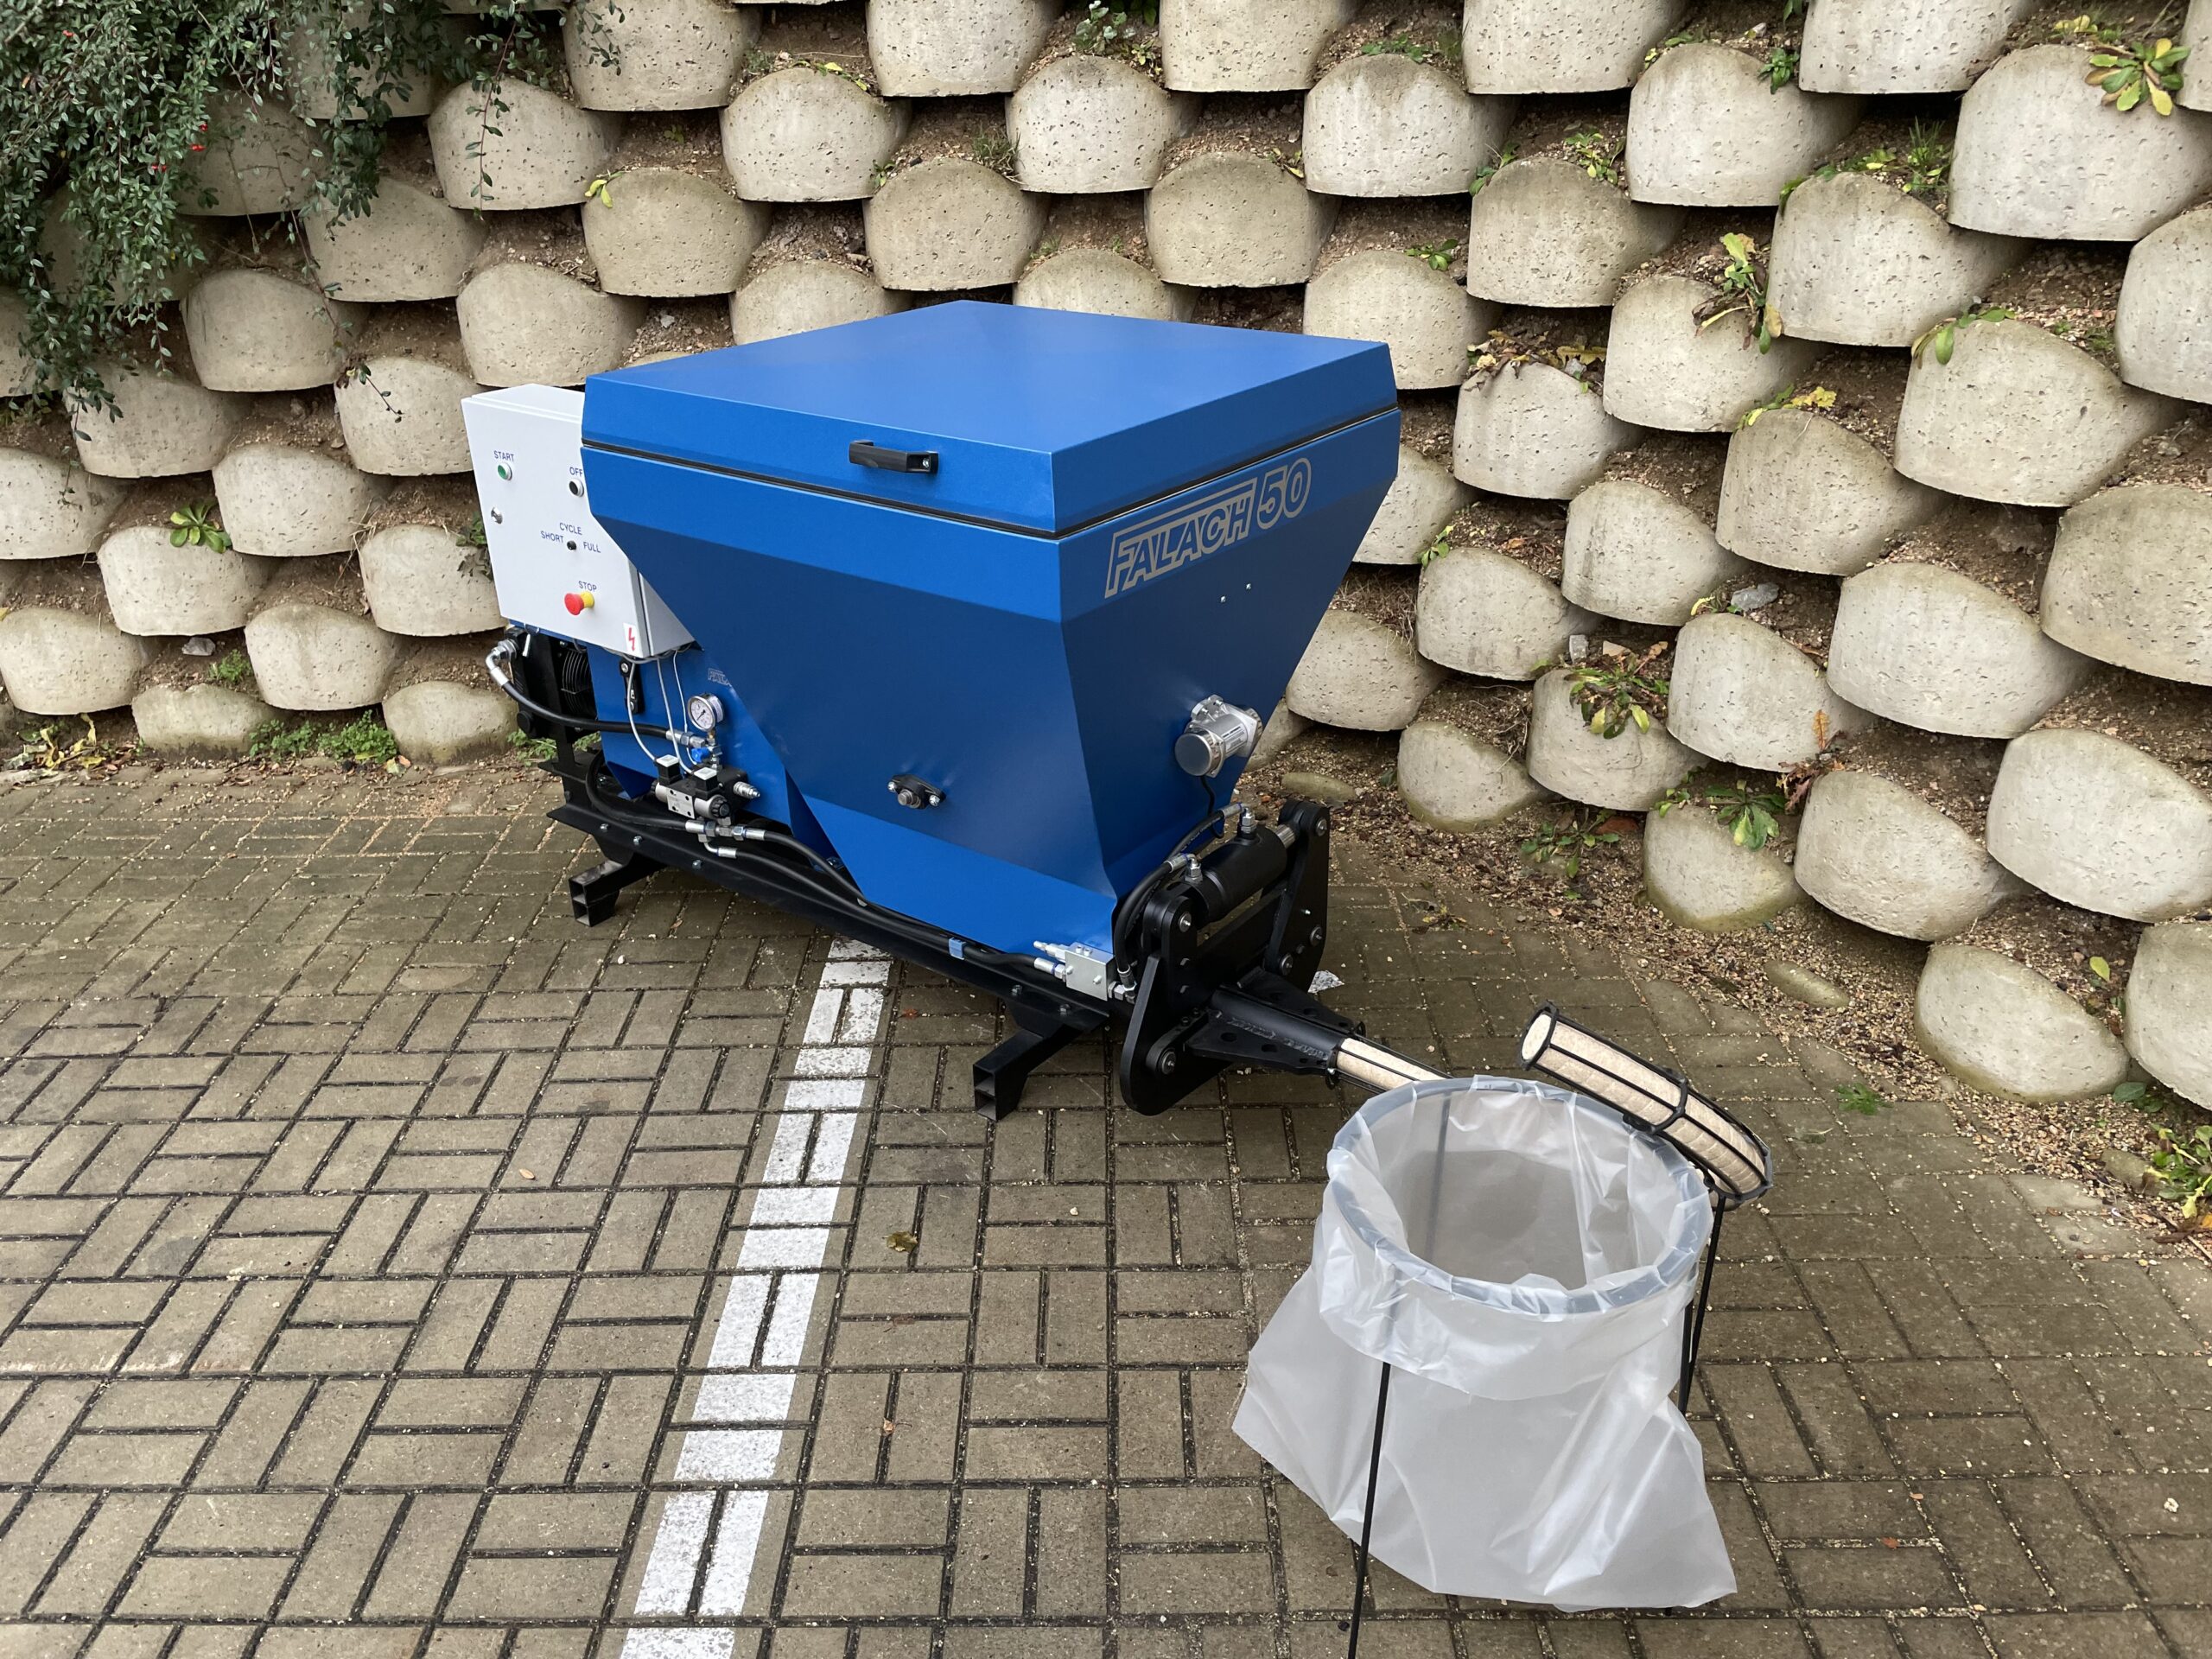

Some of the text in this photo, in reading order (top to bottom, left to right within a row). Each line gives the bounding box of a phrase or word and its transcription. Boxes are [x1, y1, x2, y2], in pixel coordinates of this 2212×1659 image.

[493, 450, 514, 461] START
[569, 467, 583, 477] OFF
[559, 522, 582, 536] CYCLE
[1104, 457, 1312, 599] FALACH 50
[540, 530, 601, 553] SHORT FULL
[579, 580, 597, 592] STOP
